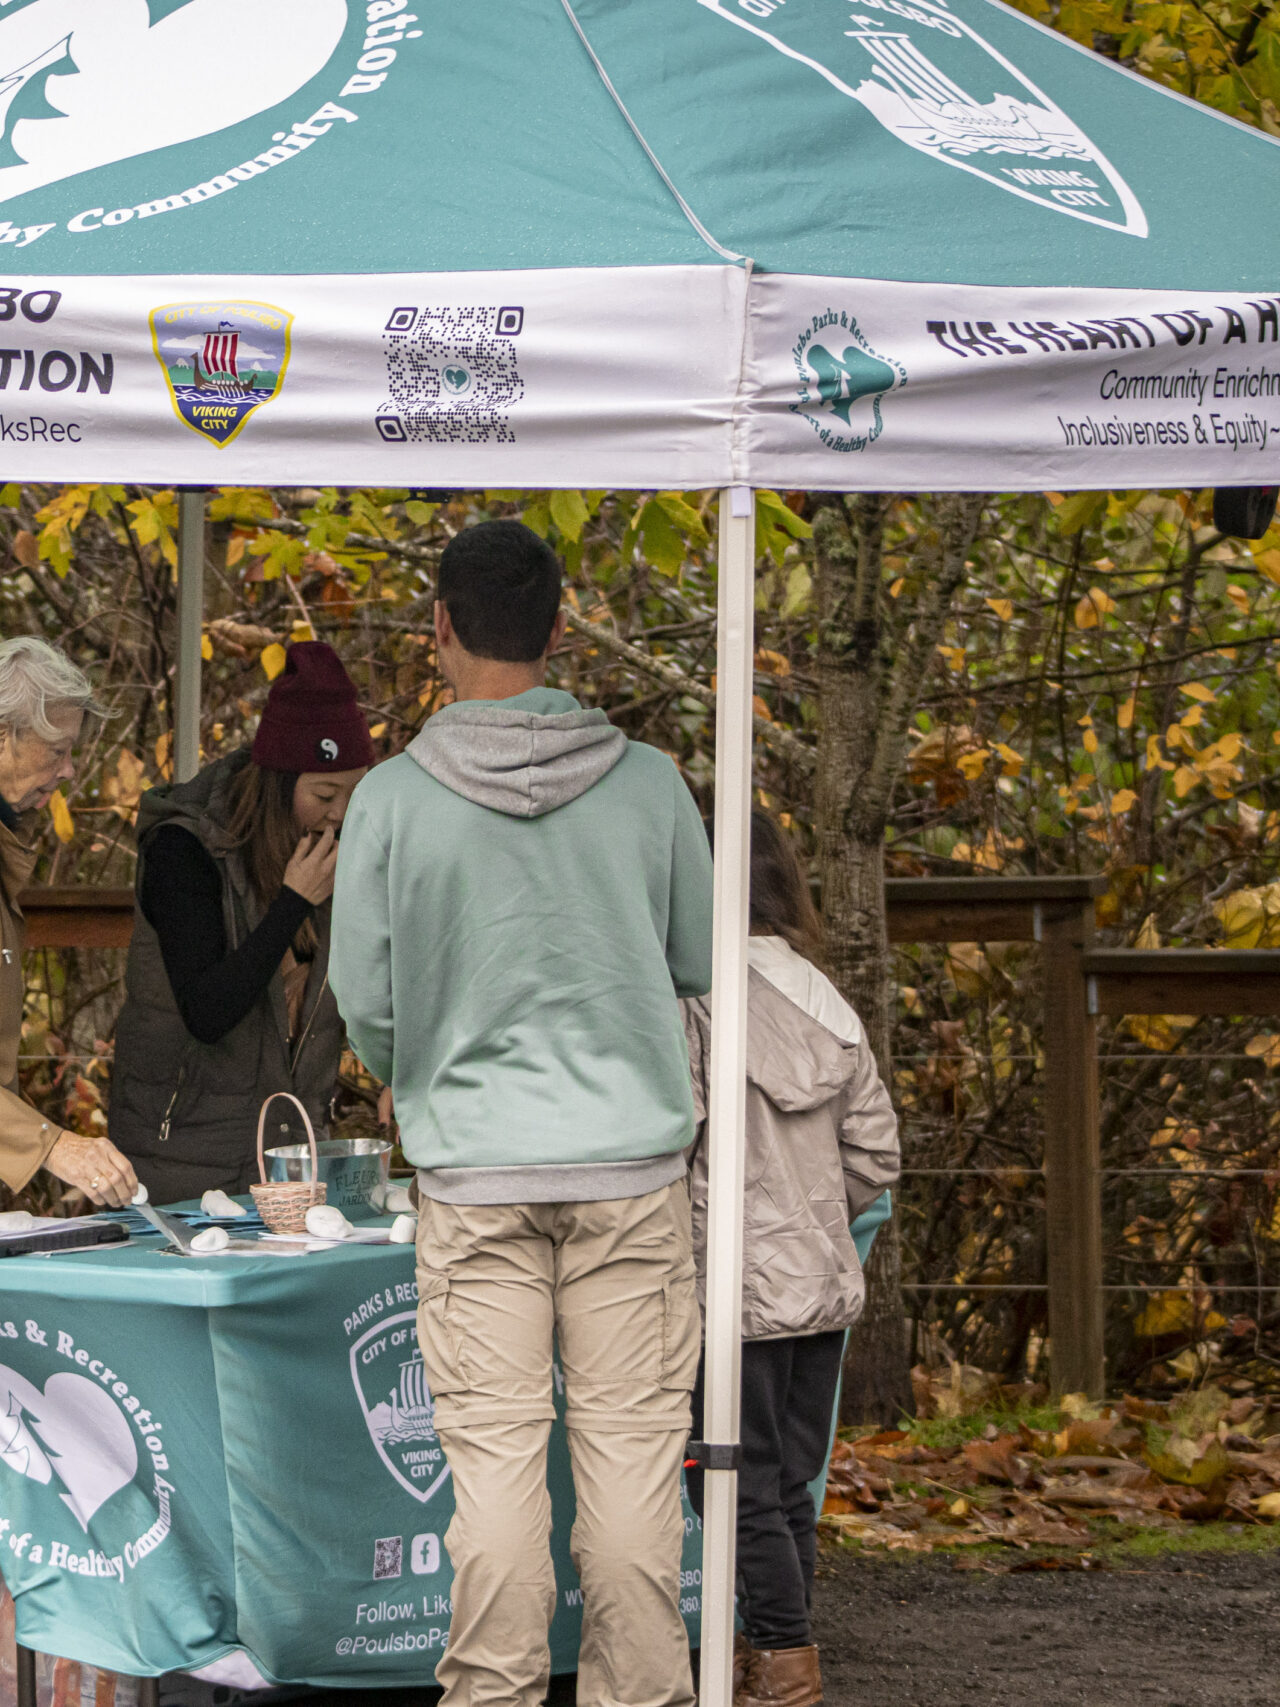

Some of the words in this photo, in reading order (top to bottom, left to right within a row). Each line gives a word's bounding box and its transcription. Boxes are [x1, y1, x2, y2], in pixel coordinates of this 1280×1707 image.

[67, 101, 359, 233] Community
[1000, 168, 1100, 188] VIKING
[1050, 189, 1111, 206] CITY
[812, 307, 838, 333] Parks
[926, 320, 1027, 358] THE
[1008, 317, 1157, 352] HEART
[1151, 309, 1214, 347] OF
[1215, 306, 1247, 344] A
[1100, 368, 1207, 405] Community
[1213, 366, 1280, 398] Enrich
[192, 406, 238, 417] VIKING
[201, 419, 228, 430] CITY
[1058, 415, 1189, 446] Inclusiveness
[1192, 413, 1209, 444] &
[343, 1293, 384, 1336] PARKS
[385, 1288, 394, 1307] &
[362, 1338, 387, 1364] CITY
[391, 1329, 407, 1346] OF
[25, 1320, 48, 1346] &
[56, 1330, 169, 1471] Recreation
[401, 1448, 441, 1465] VIKING
[410, 1463, 435, 1478] CITY
[9, 1533, 32, 1558] of
[28, 1545, 42, 1563] a
[48, 1541, 124, 1583] Healthy
[355, 1601, 417, 1625] Follow,
[335, 1627, 450, 1656] @PoulsboPa
